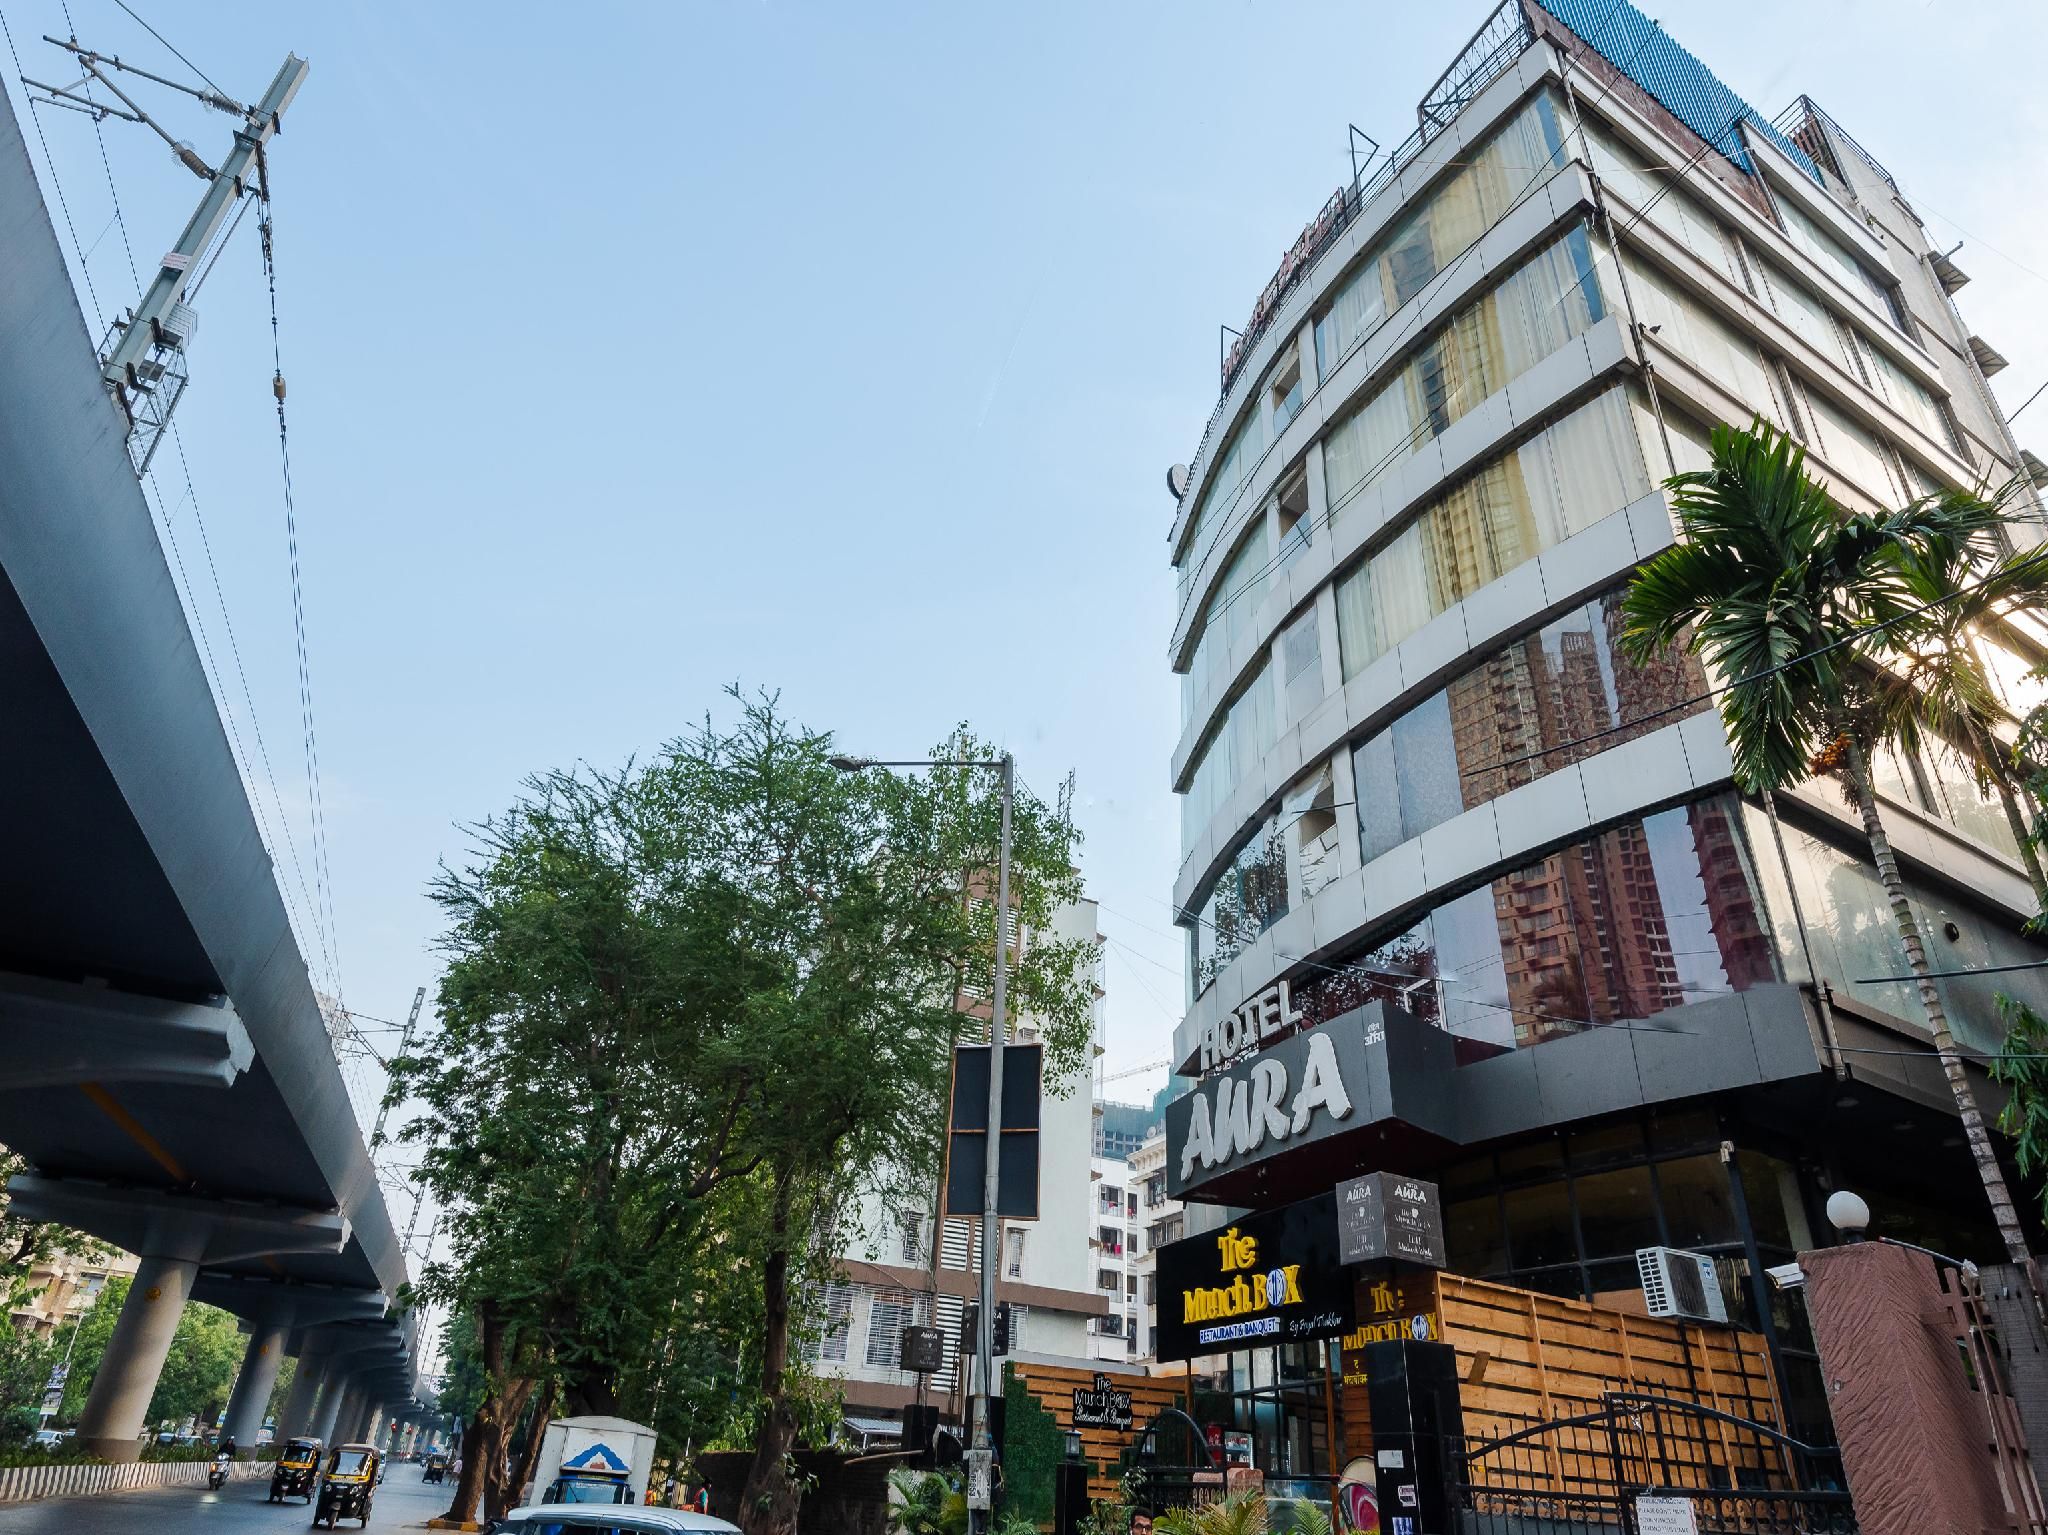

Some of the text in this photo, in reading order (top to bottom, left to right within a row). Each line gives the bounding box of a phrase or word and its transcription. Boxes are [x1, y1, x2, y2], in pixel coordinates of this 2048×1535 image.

[1200, 980, 1303, 1071] HOTEL
[1181, 1032, 1352, 1182] AURA
[1346, 1184, 1372, 1203] AURA
[1394, 1184, 1427, 1203] AURA
[1200, 1322, 1239, 1344] RESTAURANT
[1244, 1317, 1279, 1336] BANQUET
[1096, 1375, 1112, 1391] The
